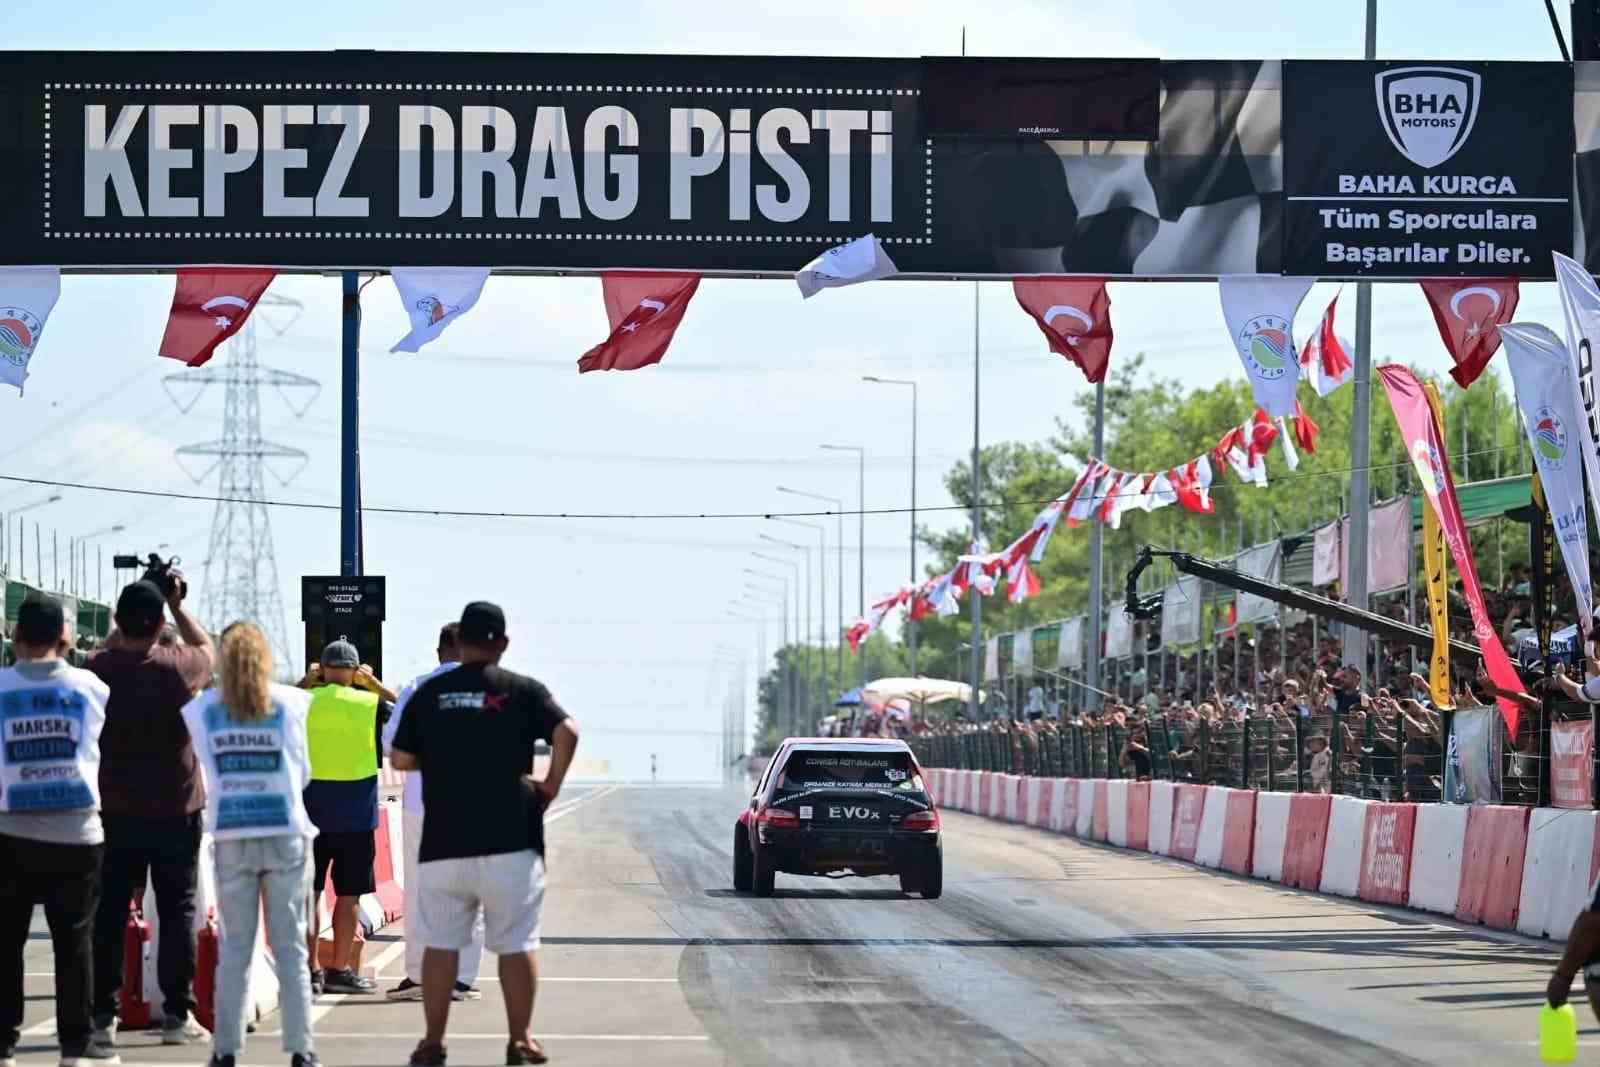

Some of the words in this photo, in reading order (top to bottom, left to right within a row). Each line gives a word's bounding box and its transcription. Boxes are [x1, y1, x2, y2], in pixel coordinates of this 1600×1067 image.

[1394, 94, 1462, 114] BHA
[1401, 118, 1456, 128] MOTORS
[83, 103, 370, 218] KEPEZ
[398, 104, 640, 221] DRAG
[1338, 175, 1416, 194] BAHA
[1423, 175, 1517, 194] KURGA
[1319, 208, 1381, 229] Tüm
[1388, 209, 1537, 234] Sporculara
[1326, 242, 1449, 268] Başarılar
[1457, 242, 1531, 263] Diler.
